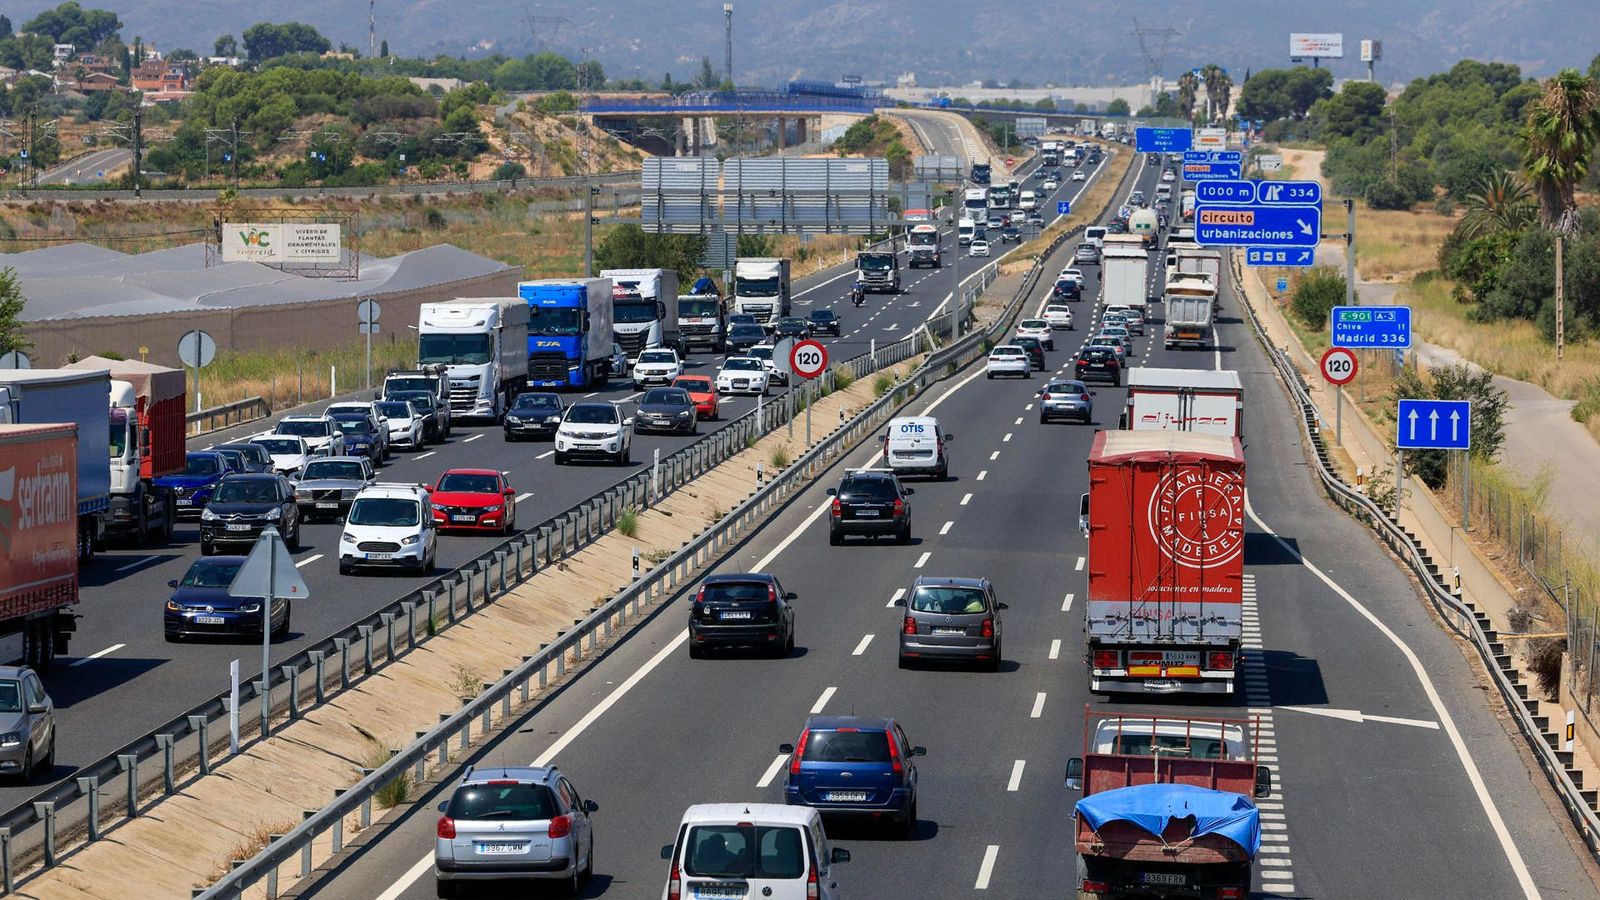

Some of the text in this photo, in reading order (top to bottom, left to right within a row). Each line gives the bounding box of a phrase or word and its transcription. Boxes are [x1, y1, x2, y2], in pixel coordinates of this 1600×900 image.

[1203, 187, 1233, 196] 1000
[1290, 189, 1314, 197] 334
[1202, 212, 1253, 223] circuito
[1202, 229, 1294, 239] urbanizaciones
[1341, 312, 1370, 320] E-901
[1337, 334, 1405, 342] Madrid 336
[798, 353, 820, 365] 120
[1328, 360, 1350, 372] 120
[901, 424, 924, 433] OTIS
[1161, 473, 1241, 513] FINANCIERA
[1179, 508, 1228, 522] FINSA
[1162, 517, 1242, 556] MADERERA
[1202, 584, 1233, 593] madera
[1168, 875, 1184, 884] FRK
